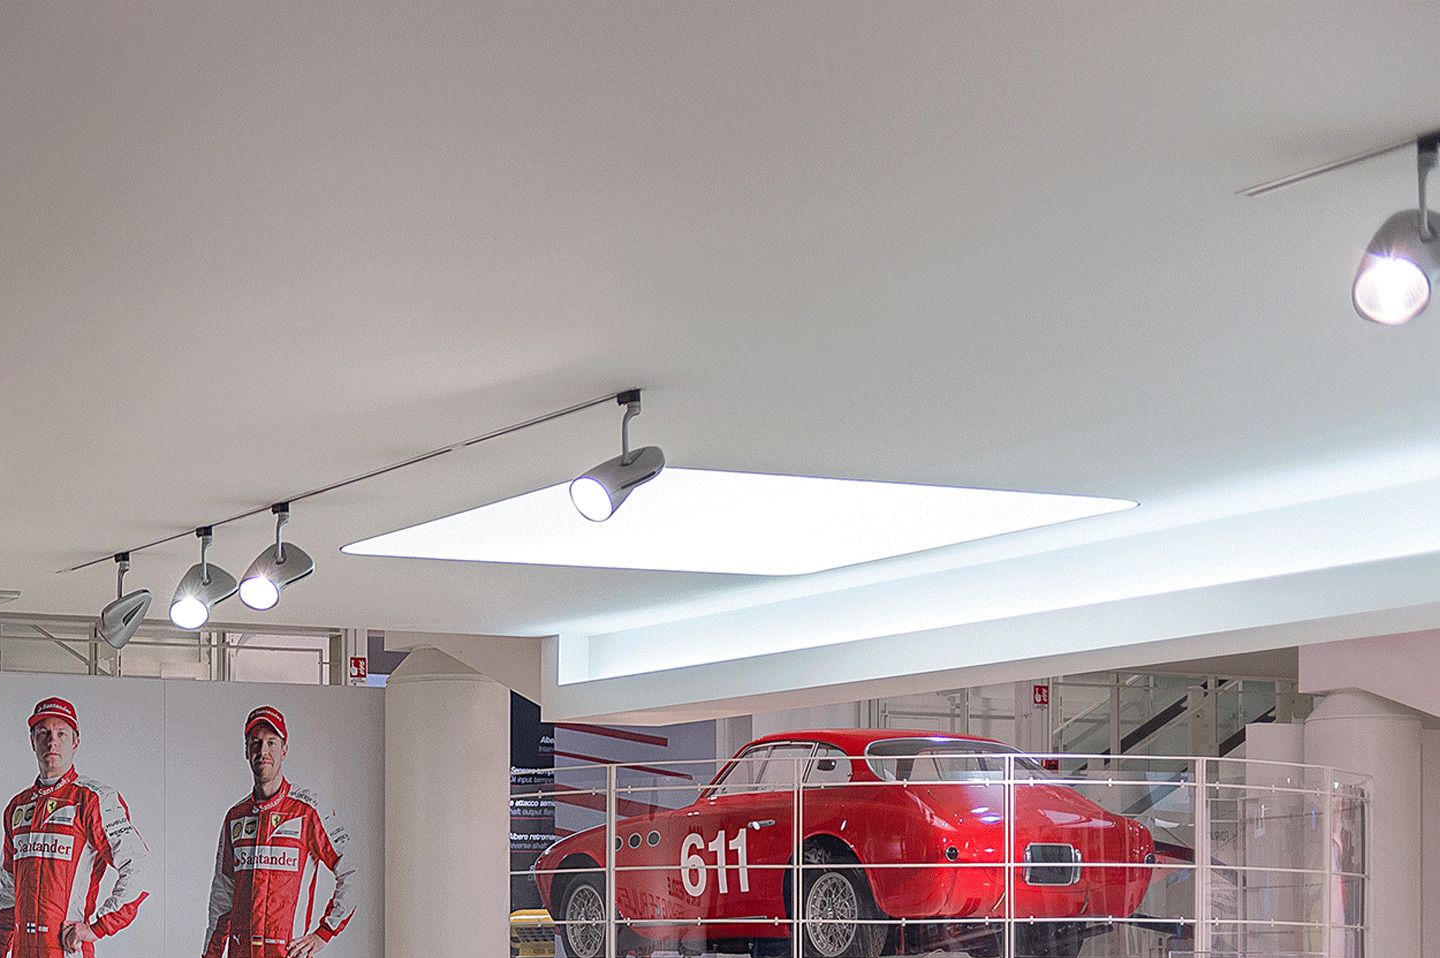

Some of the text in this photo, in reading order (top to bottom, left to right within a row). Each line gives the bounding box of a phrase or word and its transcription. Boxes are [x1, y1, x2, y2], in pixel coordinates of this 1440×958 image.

[17, 839, 71, 856] Santander
[240, 851, 298, 868] Santander
[680, 828, 749, 897] 611
